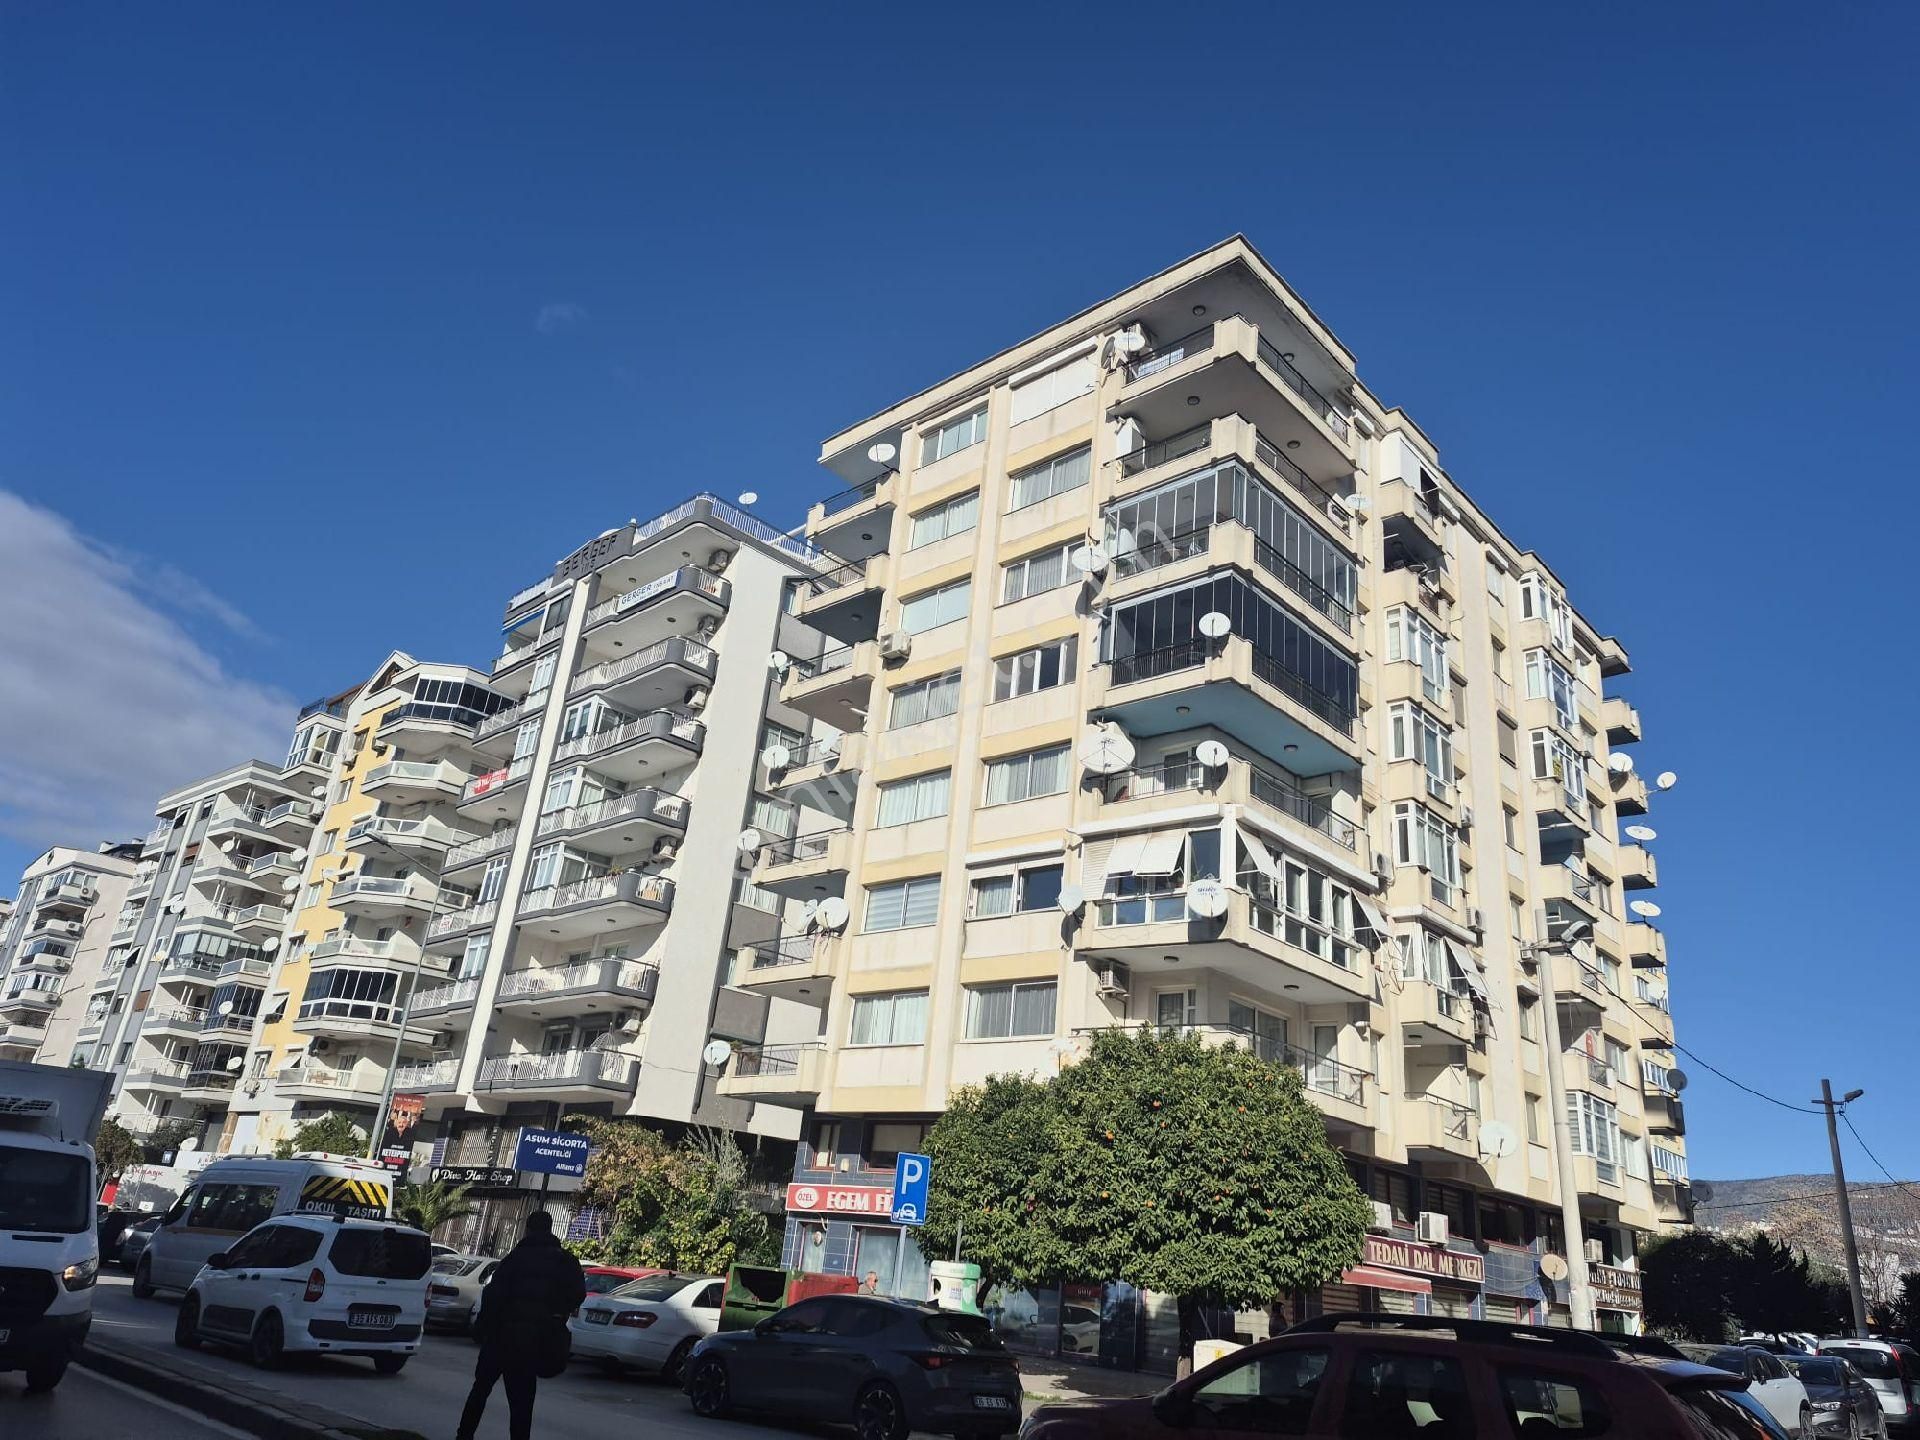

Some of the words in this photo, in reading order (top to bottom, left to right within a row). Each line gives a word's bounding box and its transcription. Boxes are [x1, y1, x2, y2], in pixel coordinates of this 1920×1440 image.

[524, 1134, 550, 1145] ASUM
[551, 1135, 587, 1150] SİGORTA
[555, 1162, 575, 1172] Allianz
[464, 1169, 488, 1182] Hair
[901, 1158, 923, 1195] P
[797, 1192, 815, 1203] ÖZEL
[305, 1200, 335, 1214] OKUL
[1368, 1240, 1410, 1267] TEDAVİ
[1413, 1249, 1435, 1272] DAL
